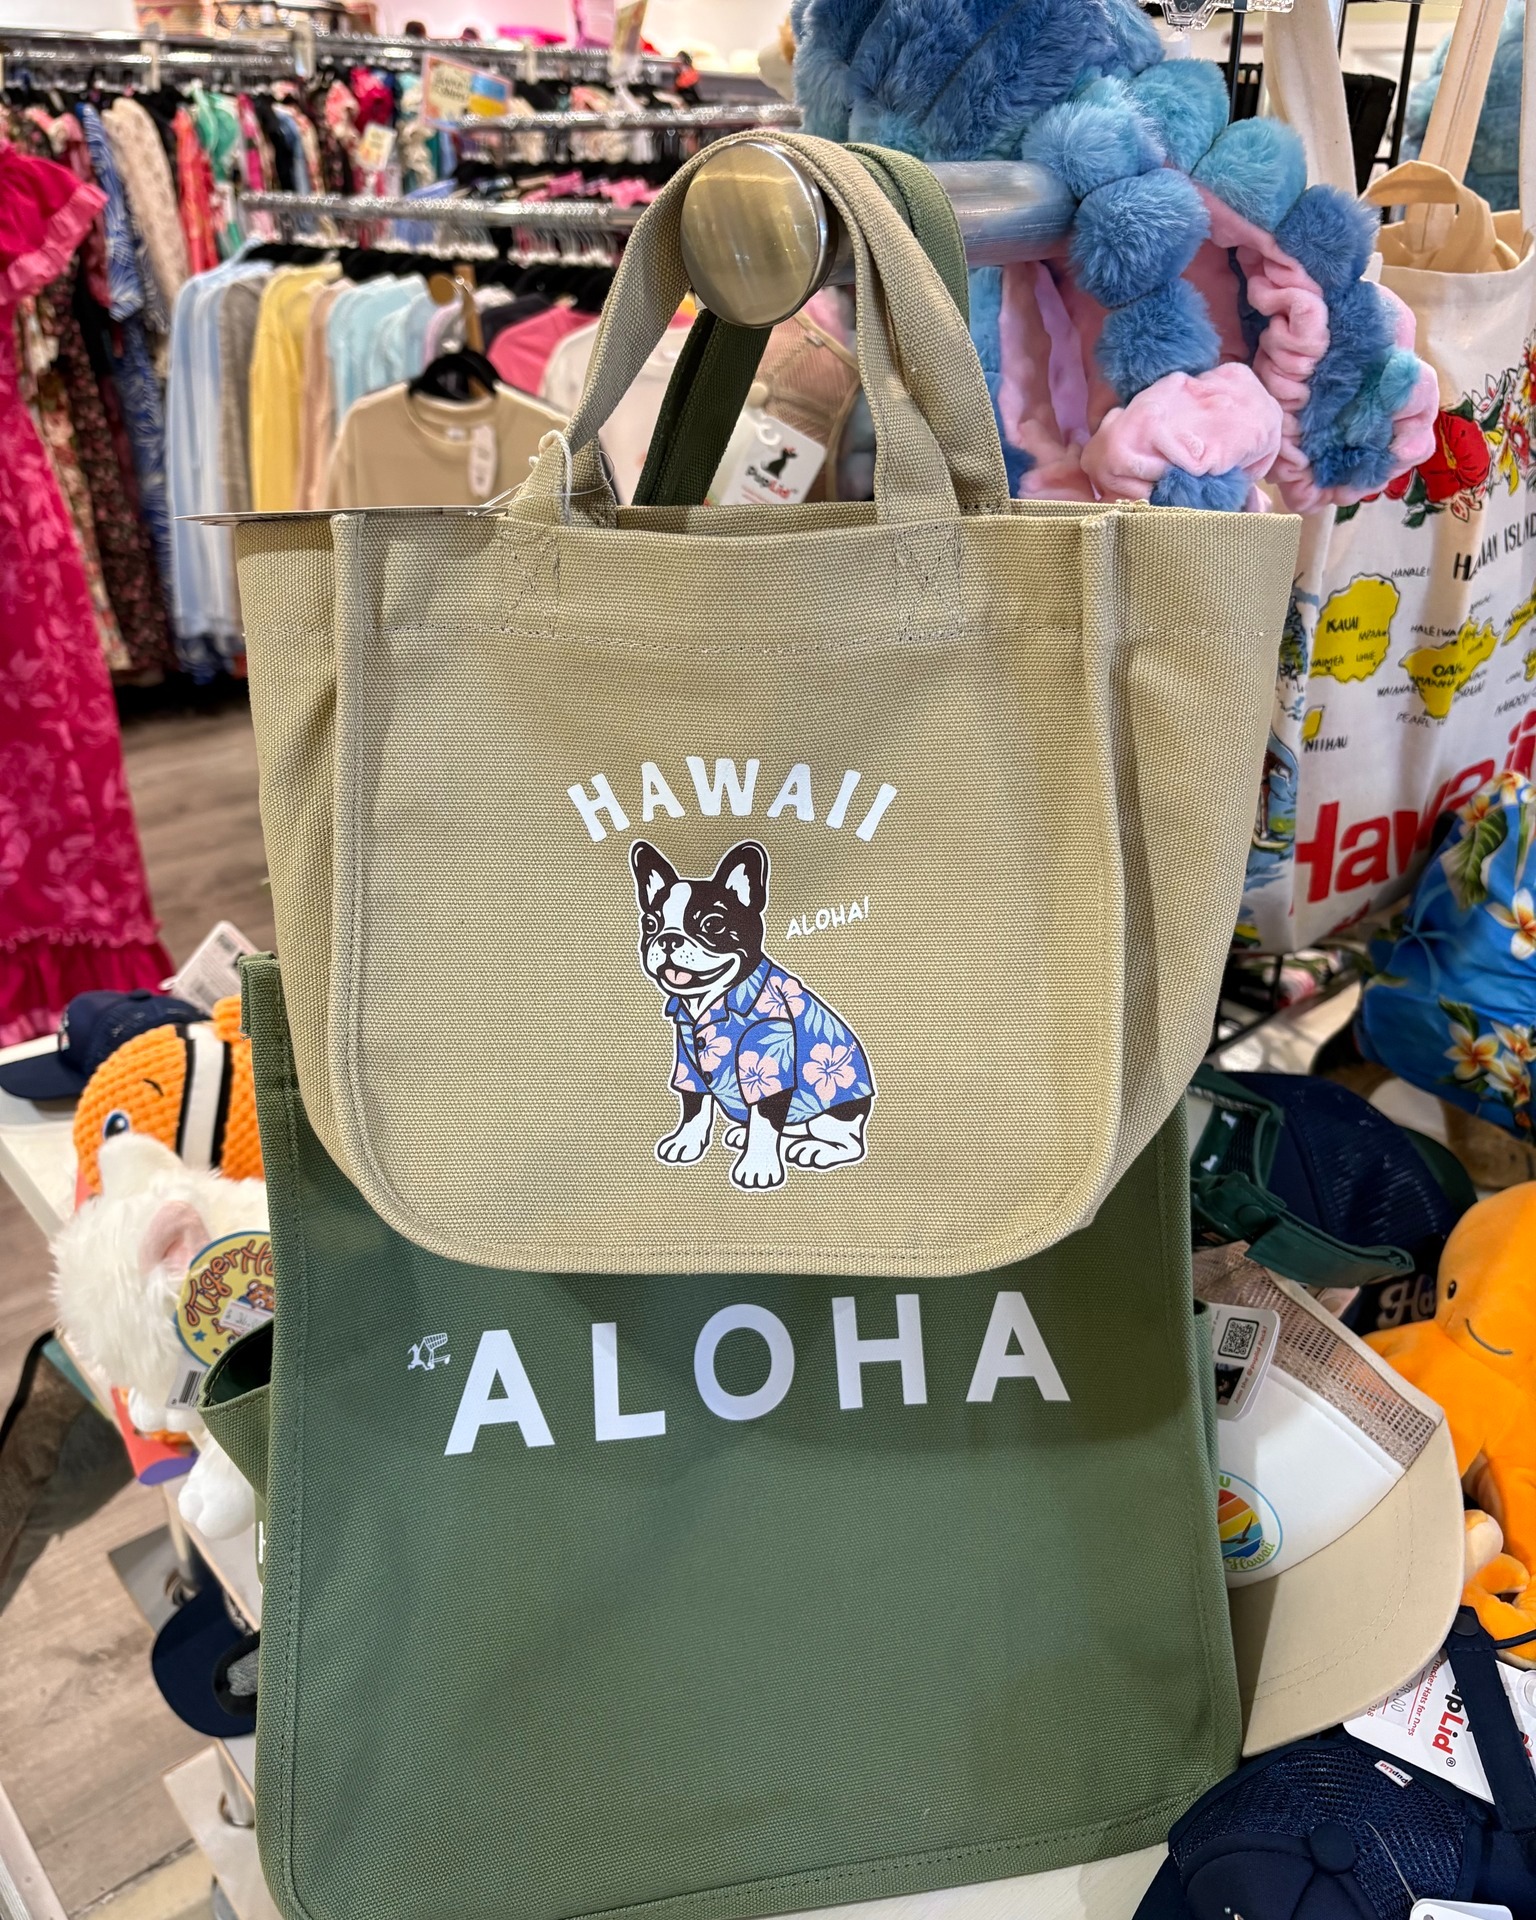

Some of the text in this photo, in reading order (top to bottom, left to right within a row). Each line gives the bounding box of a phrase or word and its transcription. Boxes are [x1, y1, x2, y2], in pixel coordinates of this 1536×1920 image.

[1304, 735, 1348, 753] NIIHAU
[566, 756, 897, 842] HAWAII
[786, 896, 870, 940] ALOHA!
[444, 1290, 1071, 1456] ALOHA
[1225, 1540, 1276, 1570] Hawaii
[1416, 1704, 1426, 1716] for
[1420, 1686, 1432, 1704] Hats
